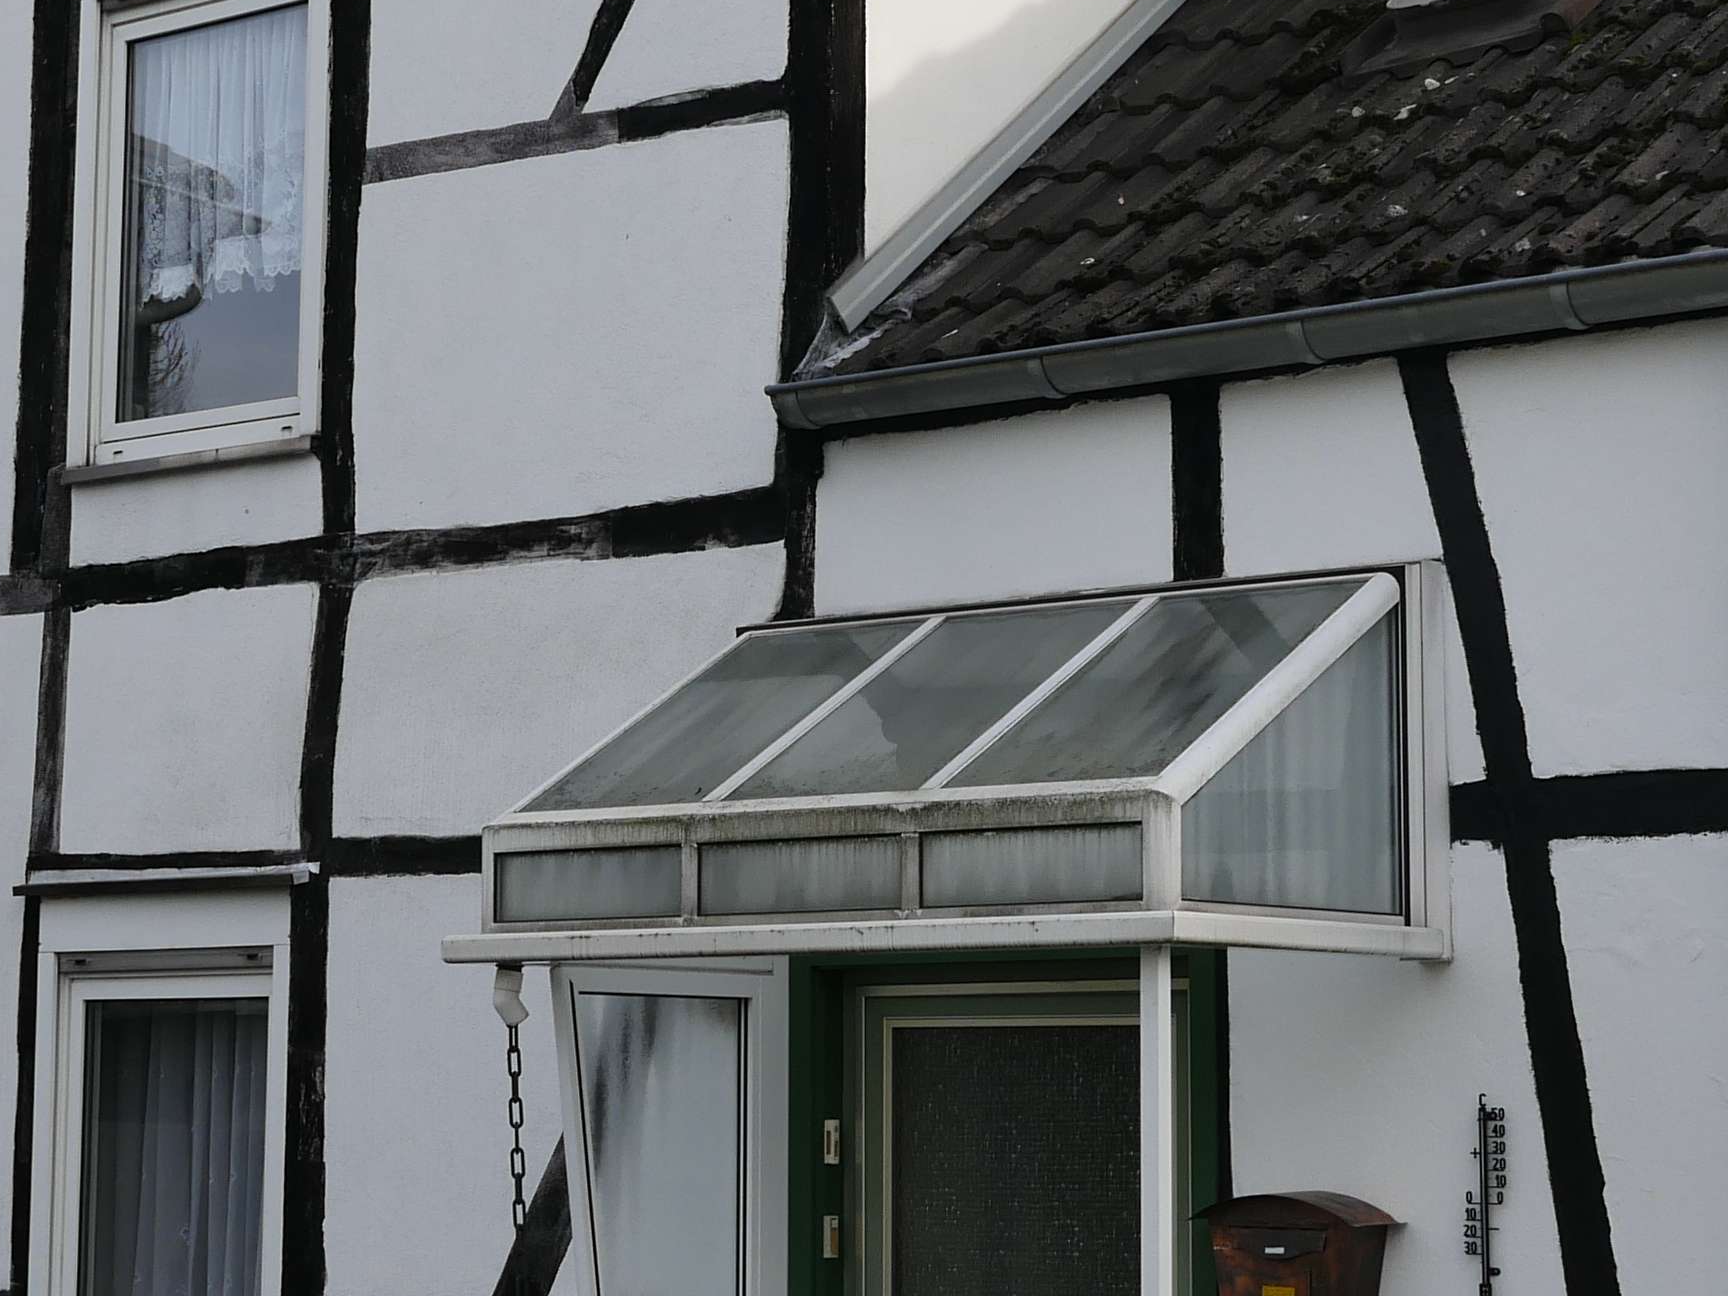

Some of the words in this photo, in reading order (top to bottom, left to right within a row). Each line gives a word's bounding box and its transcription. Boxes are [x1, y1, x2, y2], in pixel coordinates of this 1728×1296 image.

[1490, 1106, 1505, 1121] 50
[1491, 1123, 1506, 1138] 40
[1491, 1140, 1506, 1154] 30
[1492, 1157, 1507, 1171] 20
[1495, 1174, 1507, 1188] 10
[1465, 1190, 1474, 1204] 0
[1496, 1190, 1505, 1204] 0
[1464, 1207, 1477, 1221] 10
[1463, 1224, 1478, 1238] 20
[1463, 1241, 1478, 1255] 30
